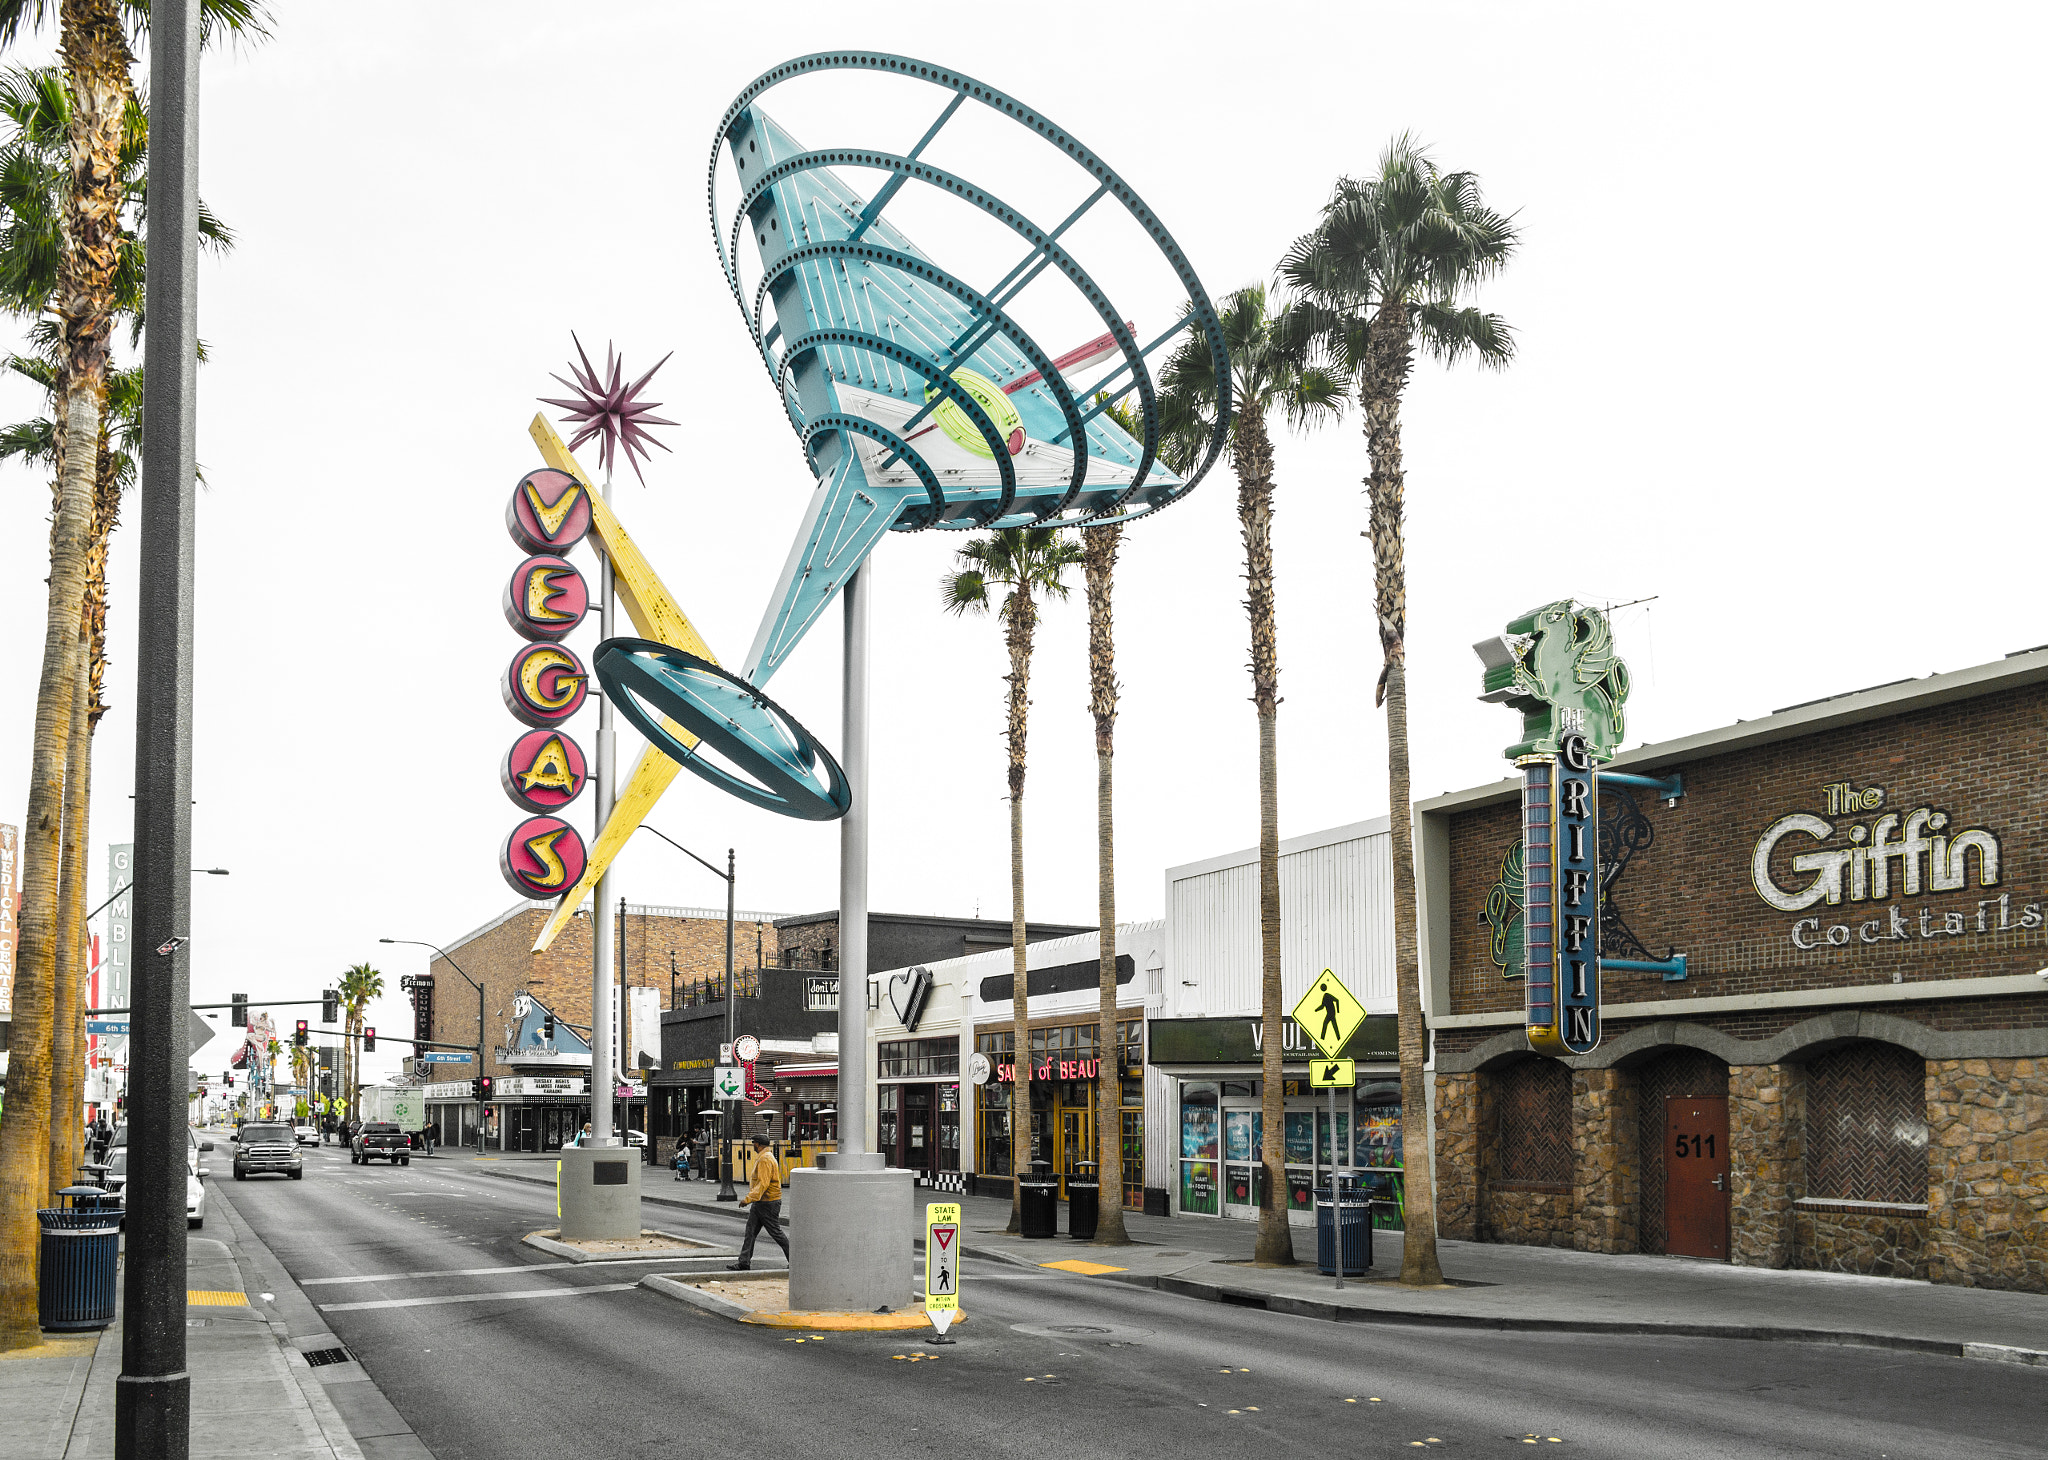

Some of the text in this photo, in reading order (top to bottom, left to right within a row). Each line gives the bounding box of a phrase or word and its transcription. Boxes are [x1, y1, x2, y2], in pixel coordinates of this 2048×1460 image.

[517, 478, 590, 889] VEGAS
[1561, 706, 1586, 731] THE
[1822, 782, 1883, 816] The
[1560, 734, 1593, 1045] GRIFFIN
[0, 850, 14, 1012] MEDICAL CENTER
[1791, 892, 2044, 950] Cocktails
[403, 977, 433, 987] Fremont
[810, 979, 829, 993] don't
[419, 988, 428, 1028] COUNTRY
[105, 1024, 119, 1032] 6th
[1251, 1022, 1317, 1051] VUL
[1038, 1056, 1053, 1080] of
[1237, 1124, 1244, 1136] 2
[1297, 1124, 1303, 1136] 9
[1675, 1134, 1715, 1158] 511
[934, 1206, 956, 1214] STATE
